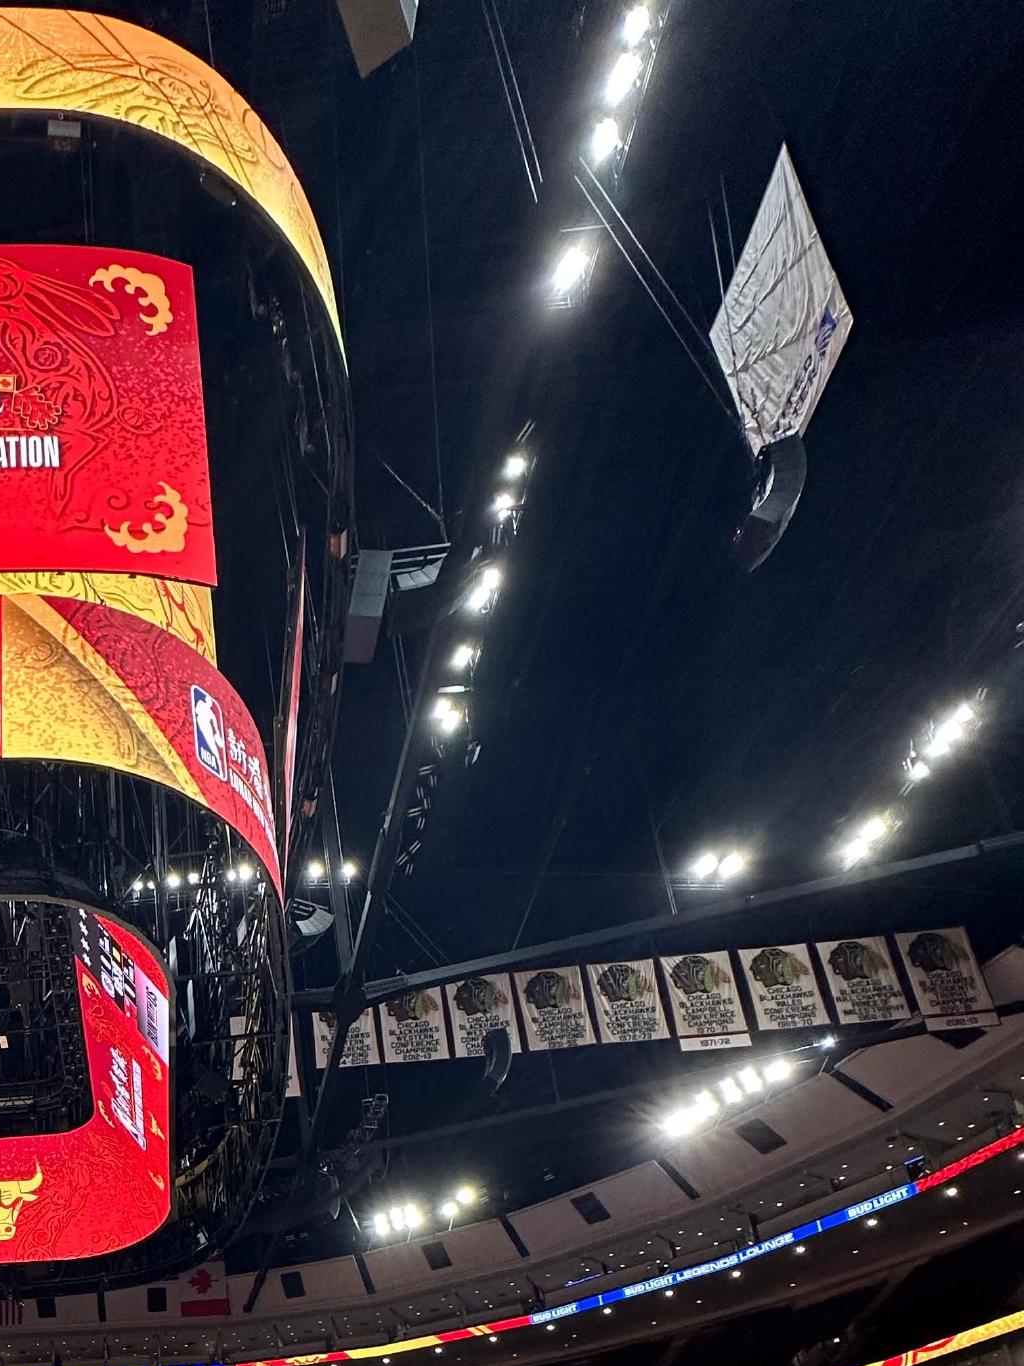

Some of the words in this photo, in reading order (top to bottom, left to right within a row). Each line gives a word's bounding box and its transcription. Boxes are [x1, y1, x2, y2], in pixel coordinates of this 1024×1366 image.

[767, 986, 802, 994] CHICAGO
[687, 993, 721, 1001] CHICAGO
[760, 991, 814, 1001] BLACKHAWKS
[611, 1001, 645, 1010] CHICAGO
[679, 998, 733, 1009] BLACKHAWKS
[540, 1007, 572, 1016] CHICAGO
[604, 1007, 656, 1016] BLACKHAWKS
[685, 1006, 727, 1015] CAMPBELL
[764, 1004, 817, 1015] CONFERENCE
[467, 1015, 500, 1024] CHICAGO
[532, 1012, 583, 1023] BLACKHAWKS
[683, 1011, 736, 1021] CONFERENCE
[770, 1011, 816, 1021] CHAMPIONS
[397, 1021, 430, 1029] CHICAGO
[687, 1018, 734, 1028] CHAMPIONS
[389, 1026, 440, 1036] BLACKHAWKS
[611, 1027, 656, 1036] CHAMPIONS
[697, 1025, 728, 1034] 1970-71
[396, 1034, 434, 1042] WESTERN
[700, 1038, 731, 1047] 1971-72
[391, 1039, 441, 1048] CONFERENCE
[395, 1046, 438, 1055] CHAMPIONS
[403, 1053, 432, 1061] 2012-13
[848, 1202, 871, 1218] BUD
[873, 1187, 909, 1211] LIGHT
[624, 1284, 642, 1297] BUD
[643, 1275, 674, 1292] LIGHT
[676, 1255, 738, 1282] LEGENDS
[739, 1232, 795, 1261] LOUNGE
[533, 1310, 551, 1323] BUD
[552, 1303, 577, 1319] LIGHT
